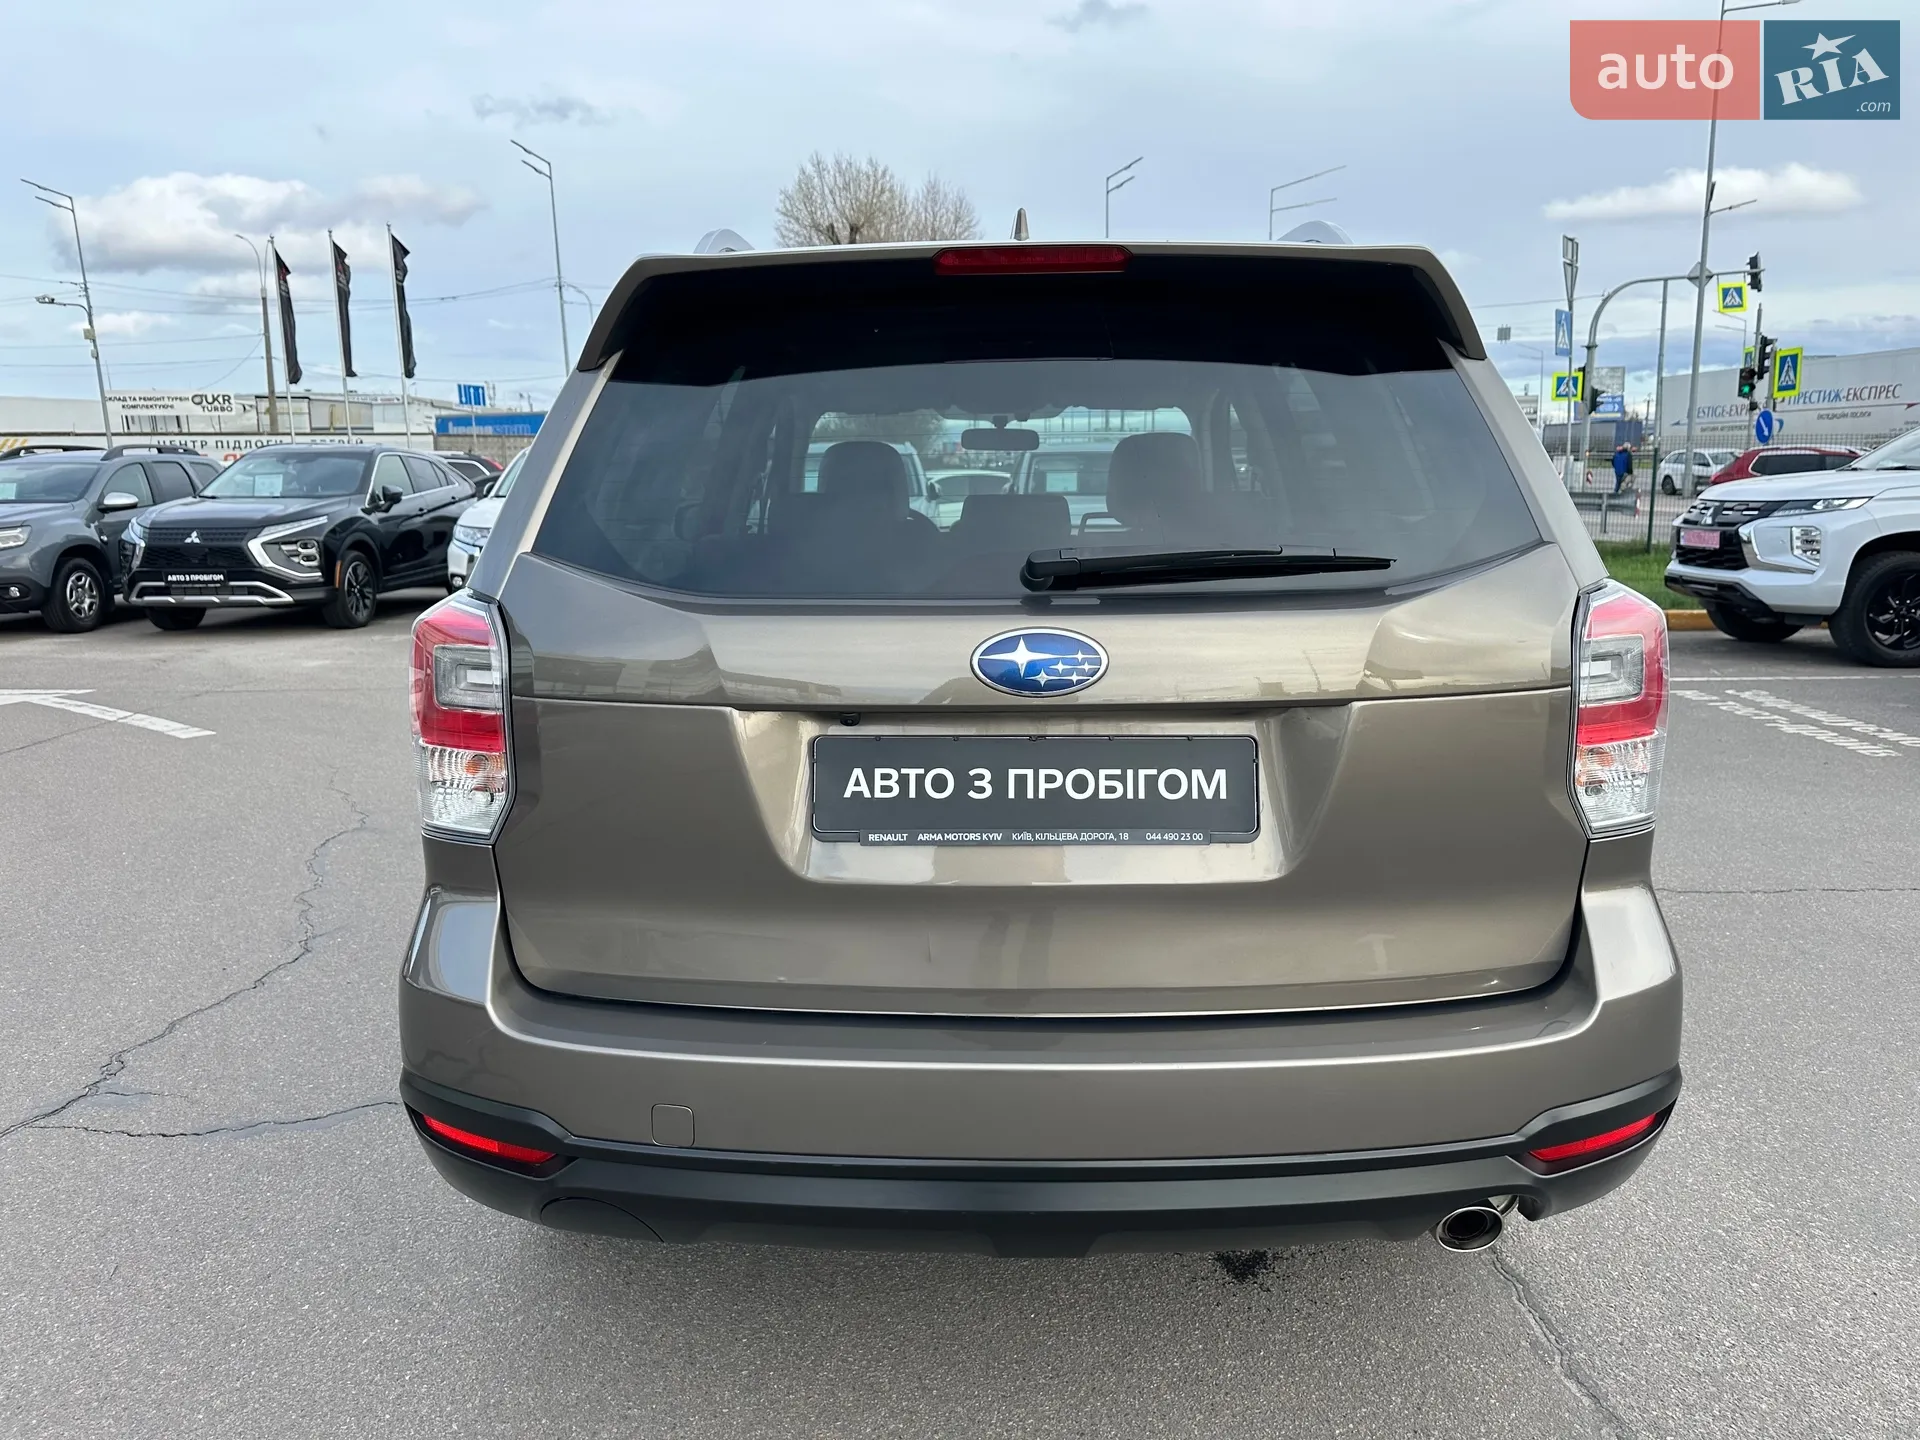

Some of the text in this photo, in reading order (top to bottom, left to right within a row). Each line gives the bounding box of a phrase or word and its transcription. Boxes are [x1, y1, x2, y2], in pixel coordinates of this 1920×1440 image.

[844, 768, 1227, 800] АВТО З ПРОБІГОМ
[868, 833, 909, 842] RENAULT
[917, 833, 943, 841] ARMA
[944, 833, 981, 841] MOTORS
[983, 833, 1003, 841] KYIV
[1035, 832, 1078, 843] КІЛЬЦЕВА
[1119, 832, 1129, 841] 18
[1145, 833, 1161, 841] 044
[1162, 833, 1178, 841] 490
[1179, 833, 1190, 841] 23
[1191, 833, 1204, 841] 00
